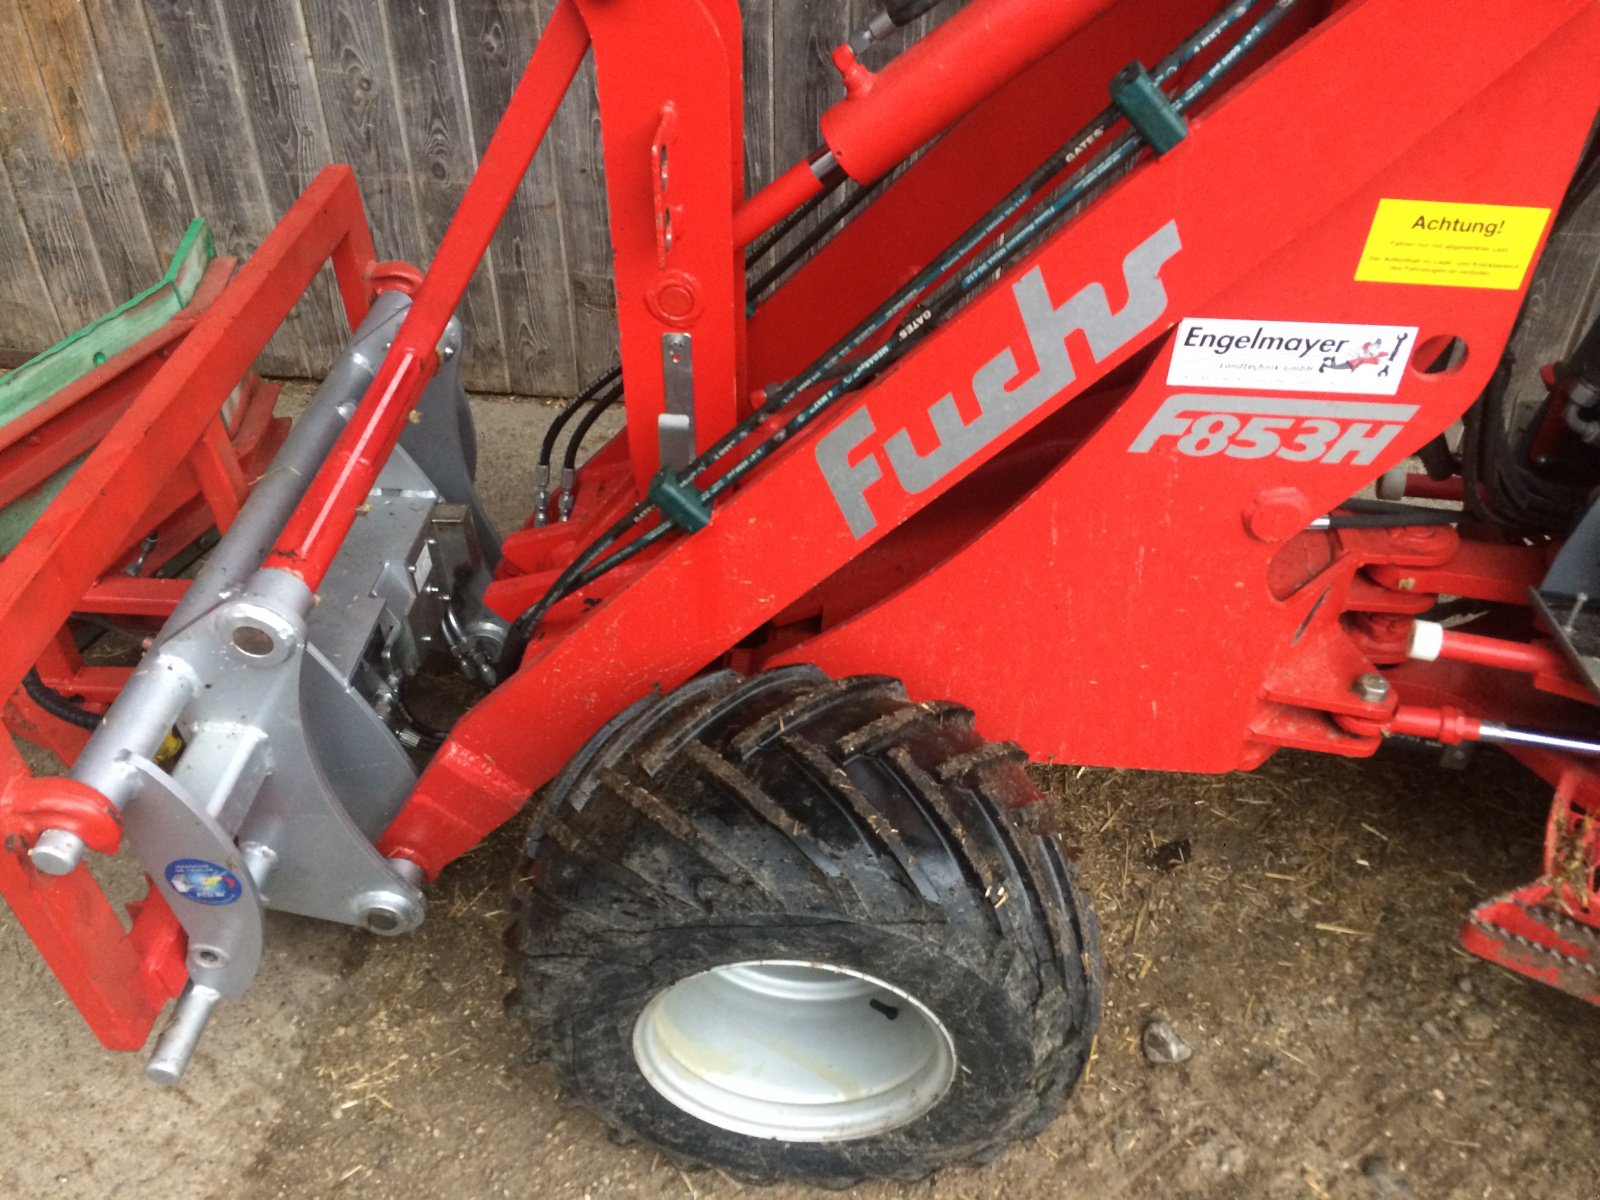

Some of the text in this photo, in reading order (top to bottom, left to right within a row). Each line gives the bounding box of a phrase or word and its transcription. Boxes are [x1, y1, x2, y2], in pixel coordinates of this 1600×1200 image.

[1411, 214, 1506, 238] Achtung!
[898, 309, 932, 340] GATES
[1183, 325, 1349, 358] Engelmayer
[815, 219, 1182, 541] Fuchs
[1127, 393, 1421, 466] F853H
